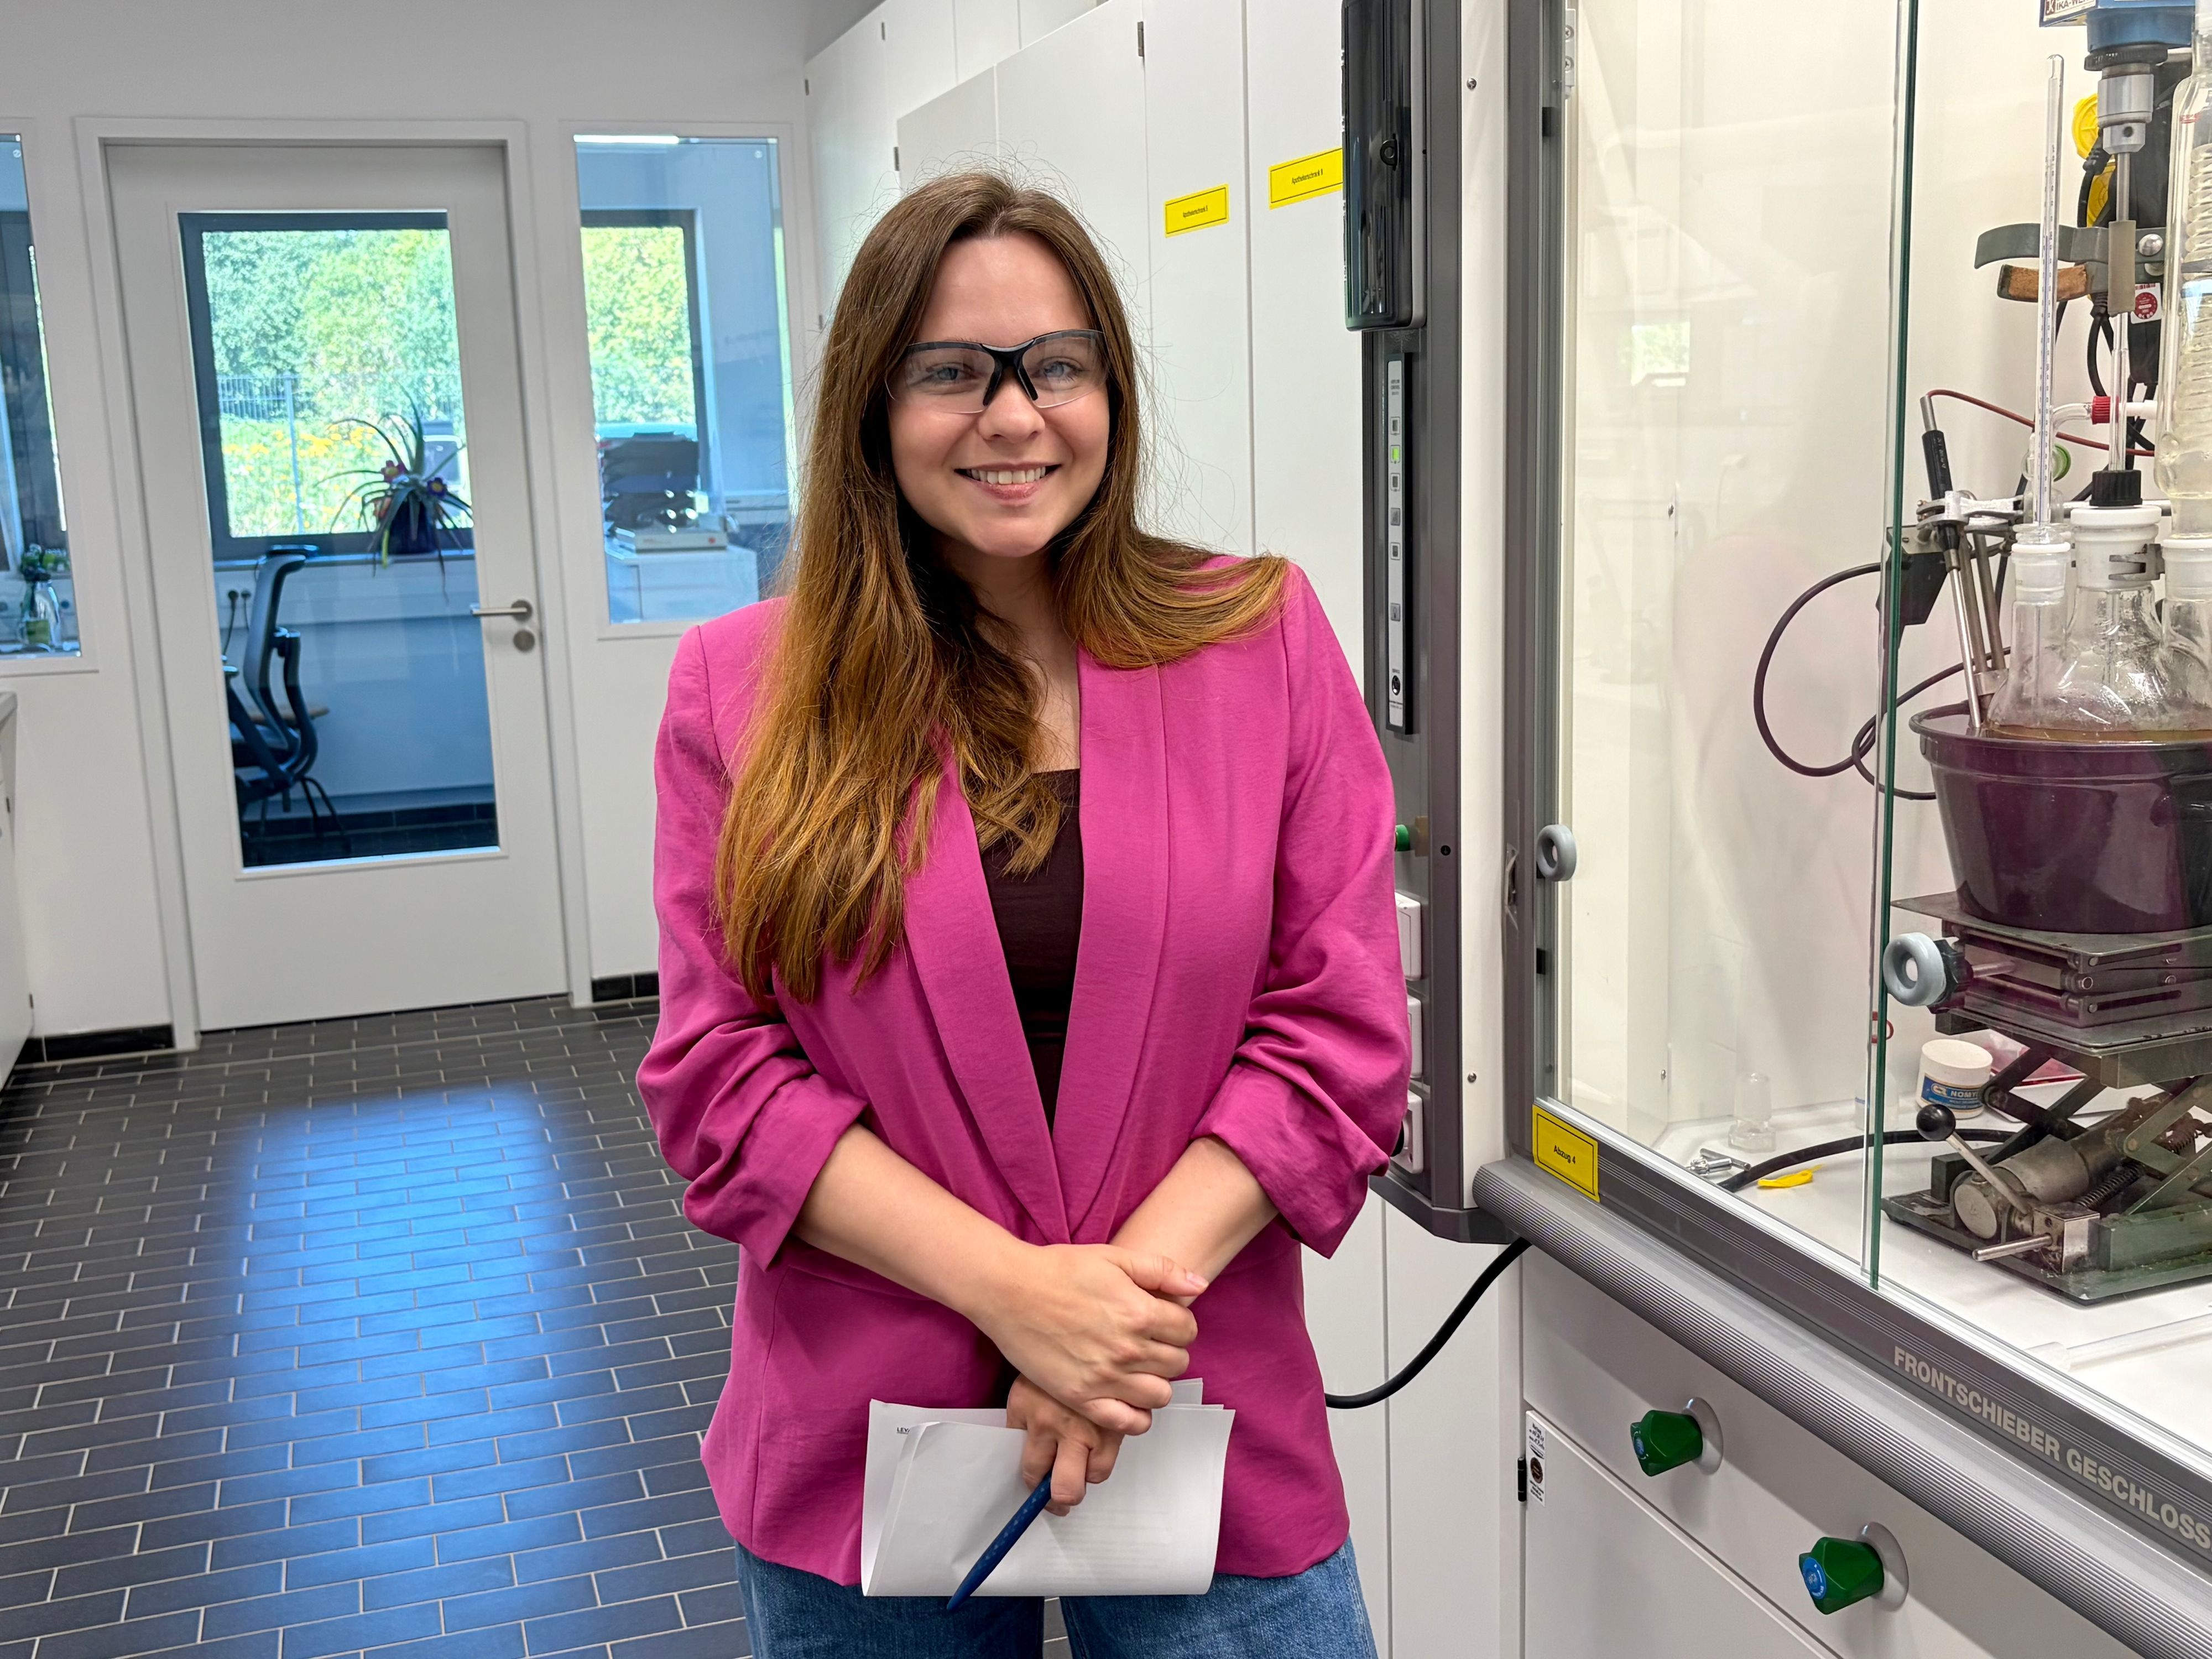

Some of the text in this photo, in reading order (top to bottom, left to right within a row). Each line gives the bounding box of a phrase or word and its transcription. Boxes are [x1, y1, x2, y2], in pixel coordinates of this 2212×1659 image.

[1553, 1145, 1576, 1165] Abzug 4
[1894, 1345, 2212, 1550] FRONTSCHIEBER GESCHLOSS
